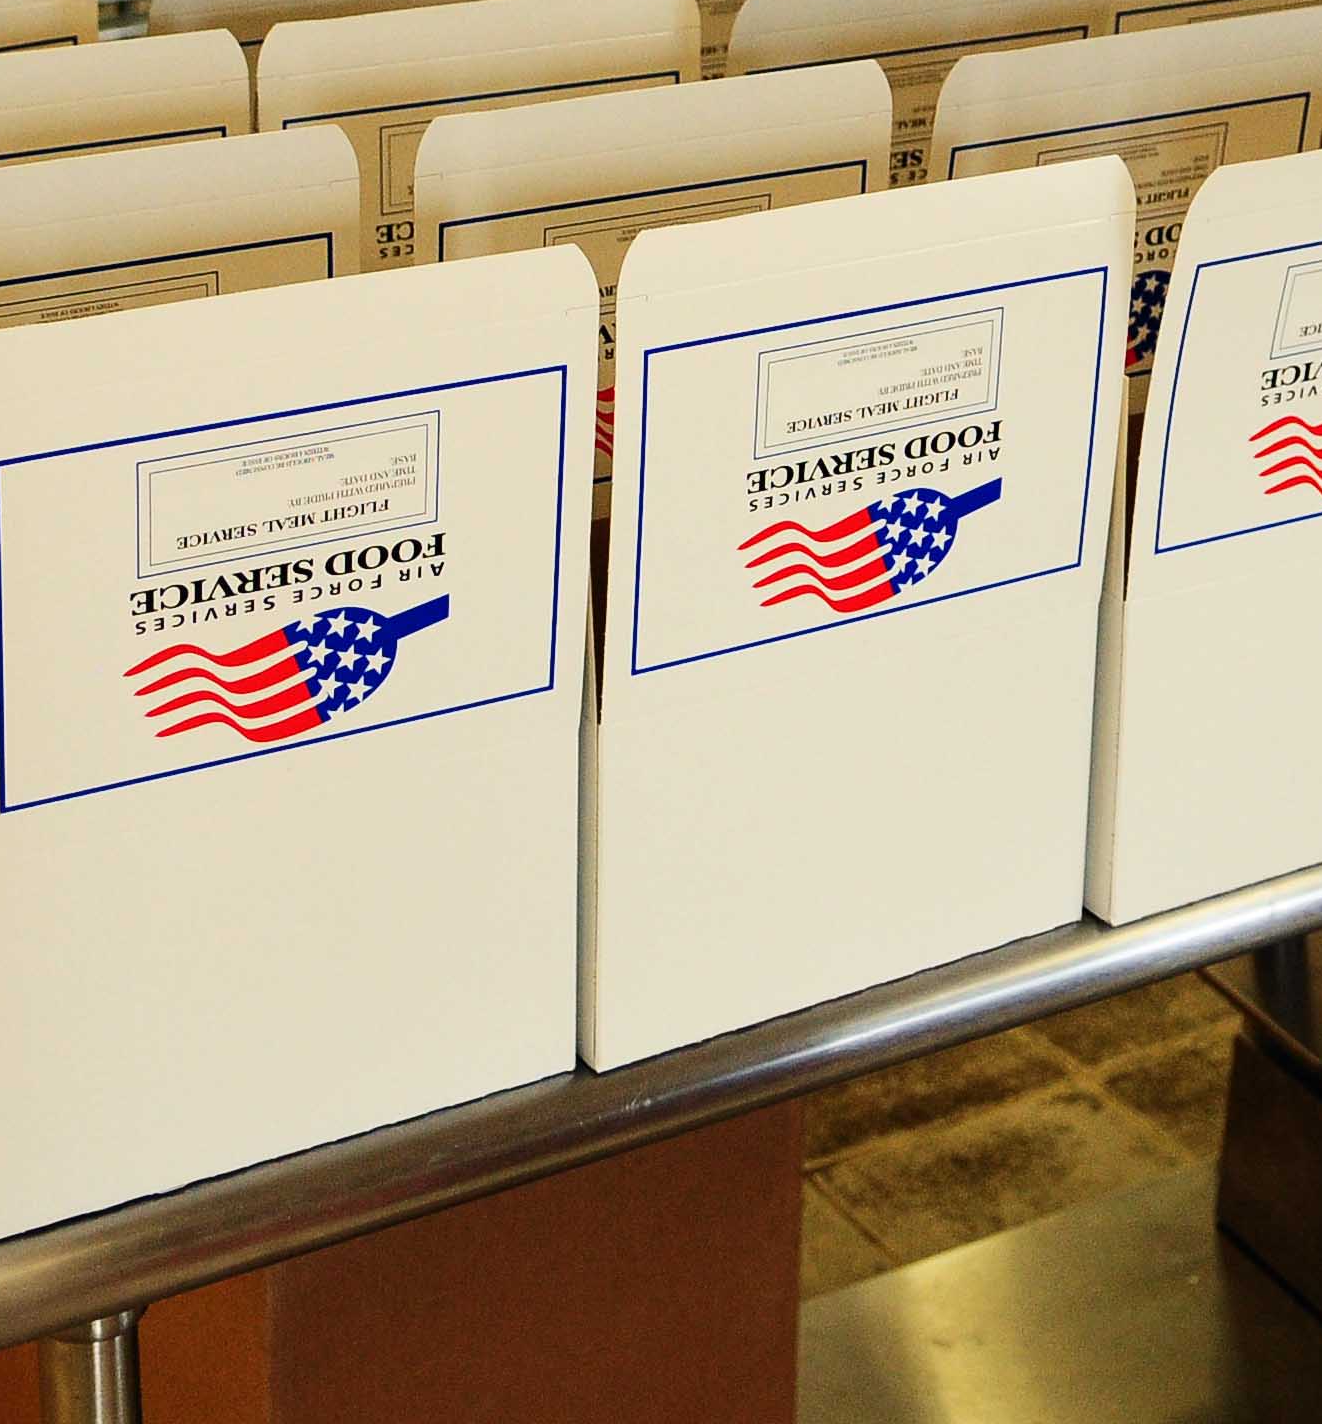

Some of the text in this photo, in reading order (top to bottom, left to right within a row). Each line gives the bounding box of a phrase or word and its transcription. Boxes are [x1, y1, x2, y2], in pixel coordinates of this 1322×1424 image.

[787, 389, 958, 433] FLIGHT MEAL SERVICE
[747, 420, 1002, 494] FOOD SERVICE
[750, 447, 1000, 512] AIR FORCE SERVICES
[177, 499, 388, 549] FLIGHT MEAL SERVICE
[130, 533, 446, 616] FOOD SERVICE
[136, 562, 444, 635] AIR FORCE SERVICES
